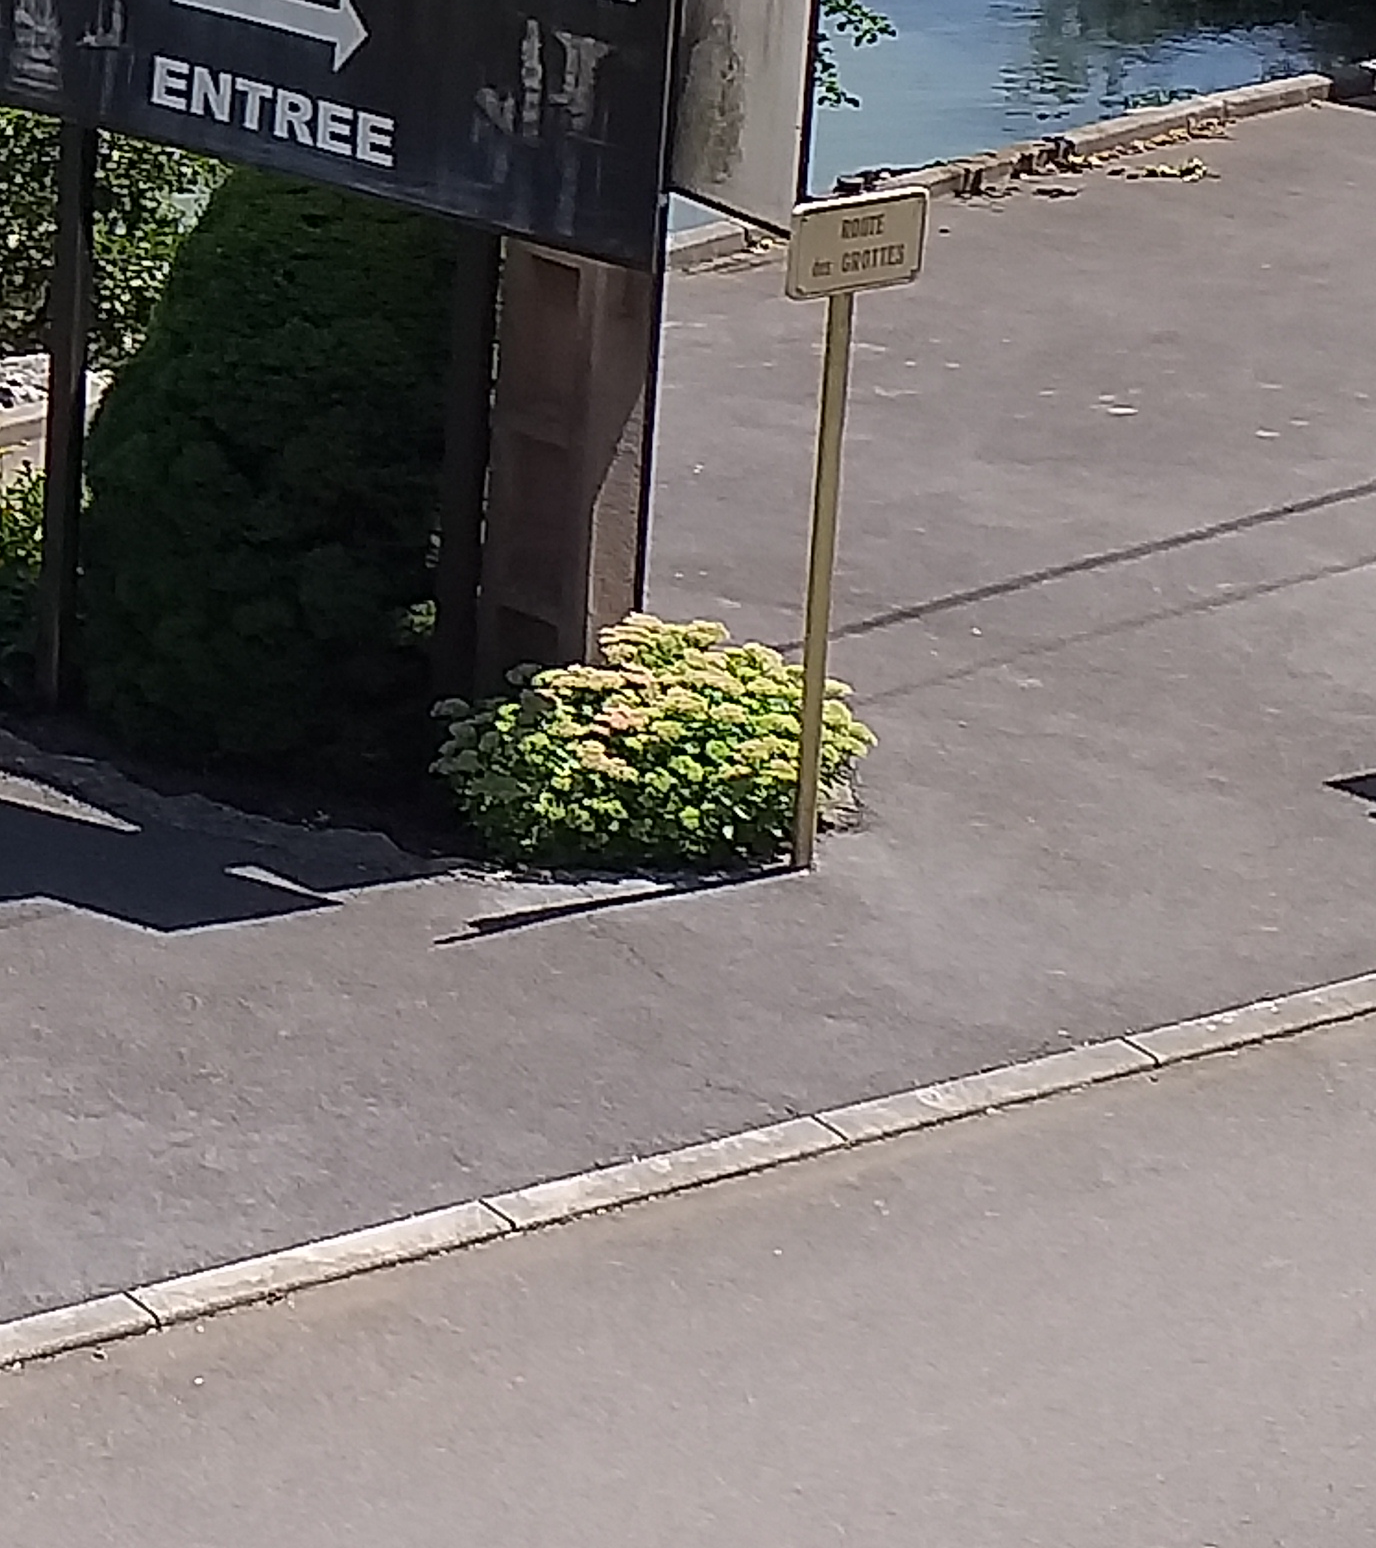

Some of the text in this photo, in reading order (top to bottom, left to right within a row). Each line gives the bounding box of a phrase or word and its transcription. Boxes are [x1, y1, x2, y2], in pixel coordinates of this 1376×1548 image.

[150, 56, 395, 167] ENTREE
[842, 214, 885, 239] ROUTE
[842, 245, 904, 273] GROTTES
